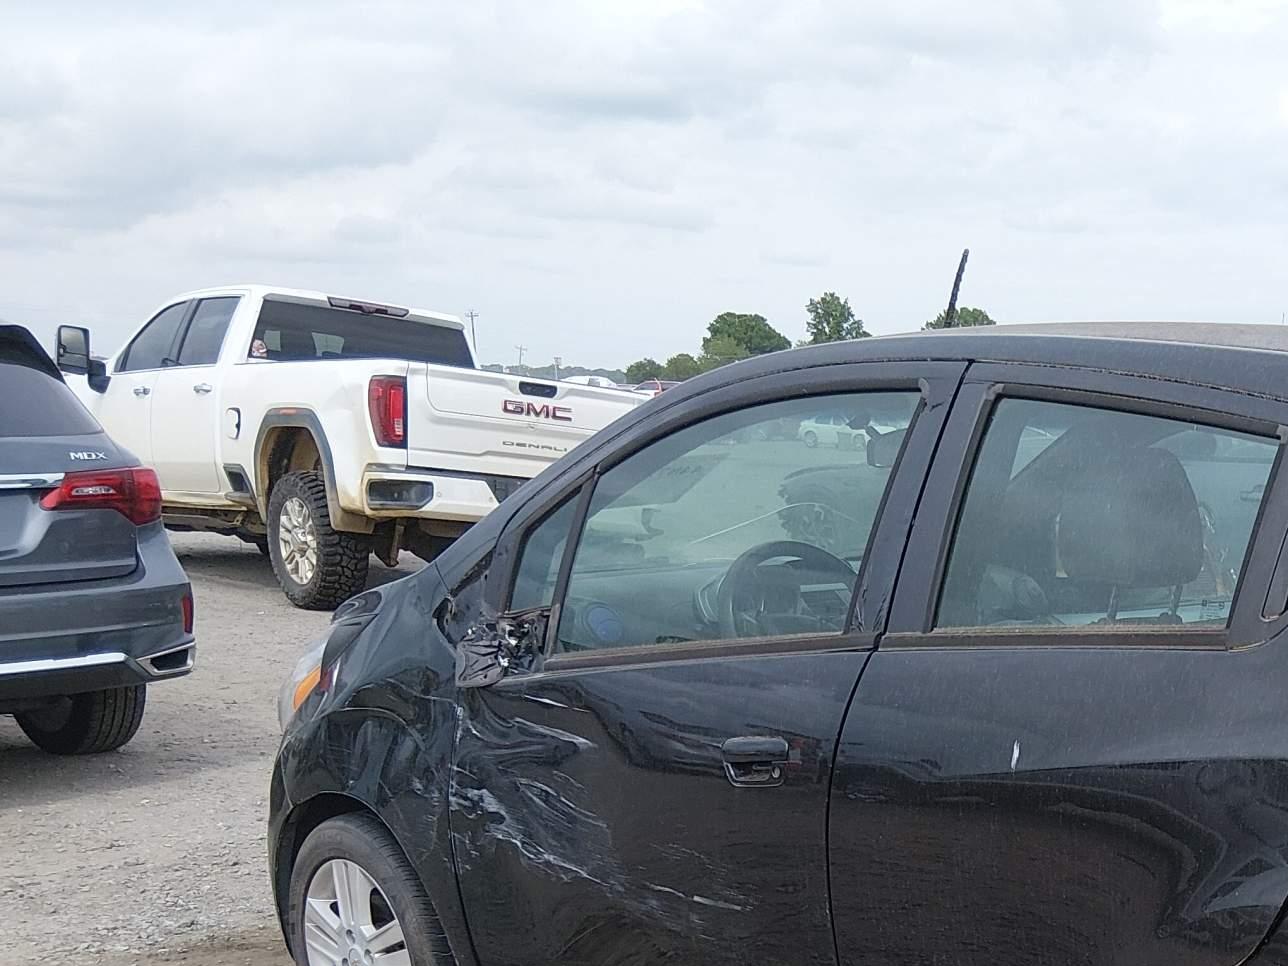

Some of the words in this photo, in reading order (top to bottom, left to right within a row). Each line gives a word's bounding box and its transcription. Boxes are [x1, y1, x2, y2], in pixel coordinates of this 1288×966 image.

[502, 399, 572, 422] GMC
[502, 441, 568, 452] DENALI
[69, 451, 108, 461] MDX
